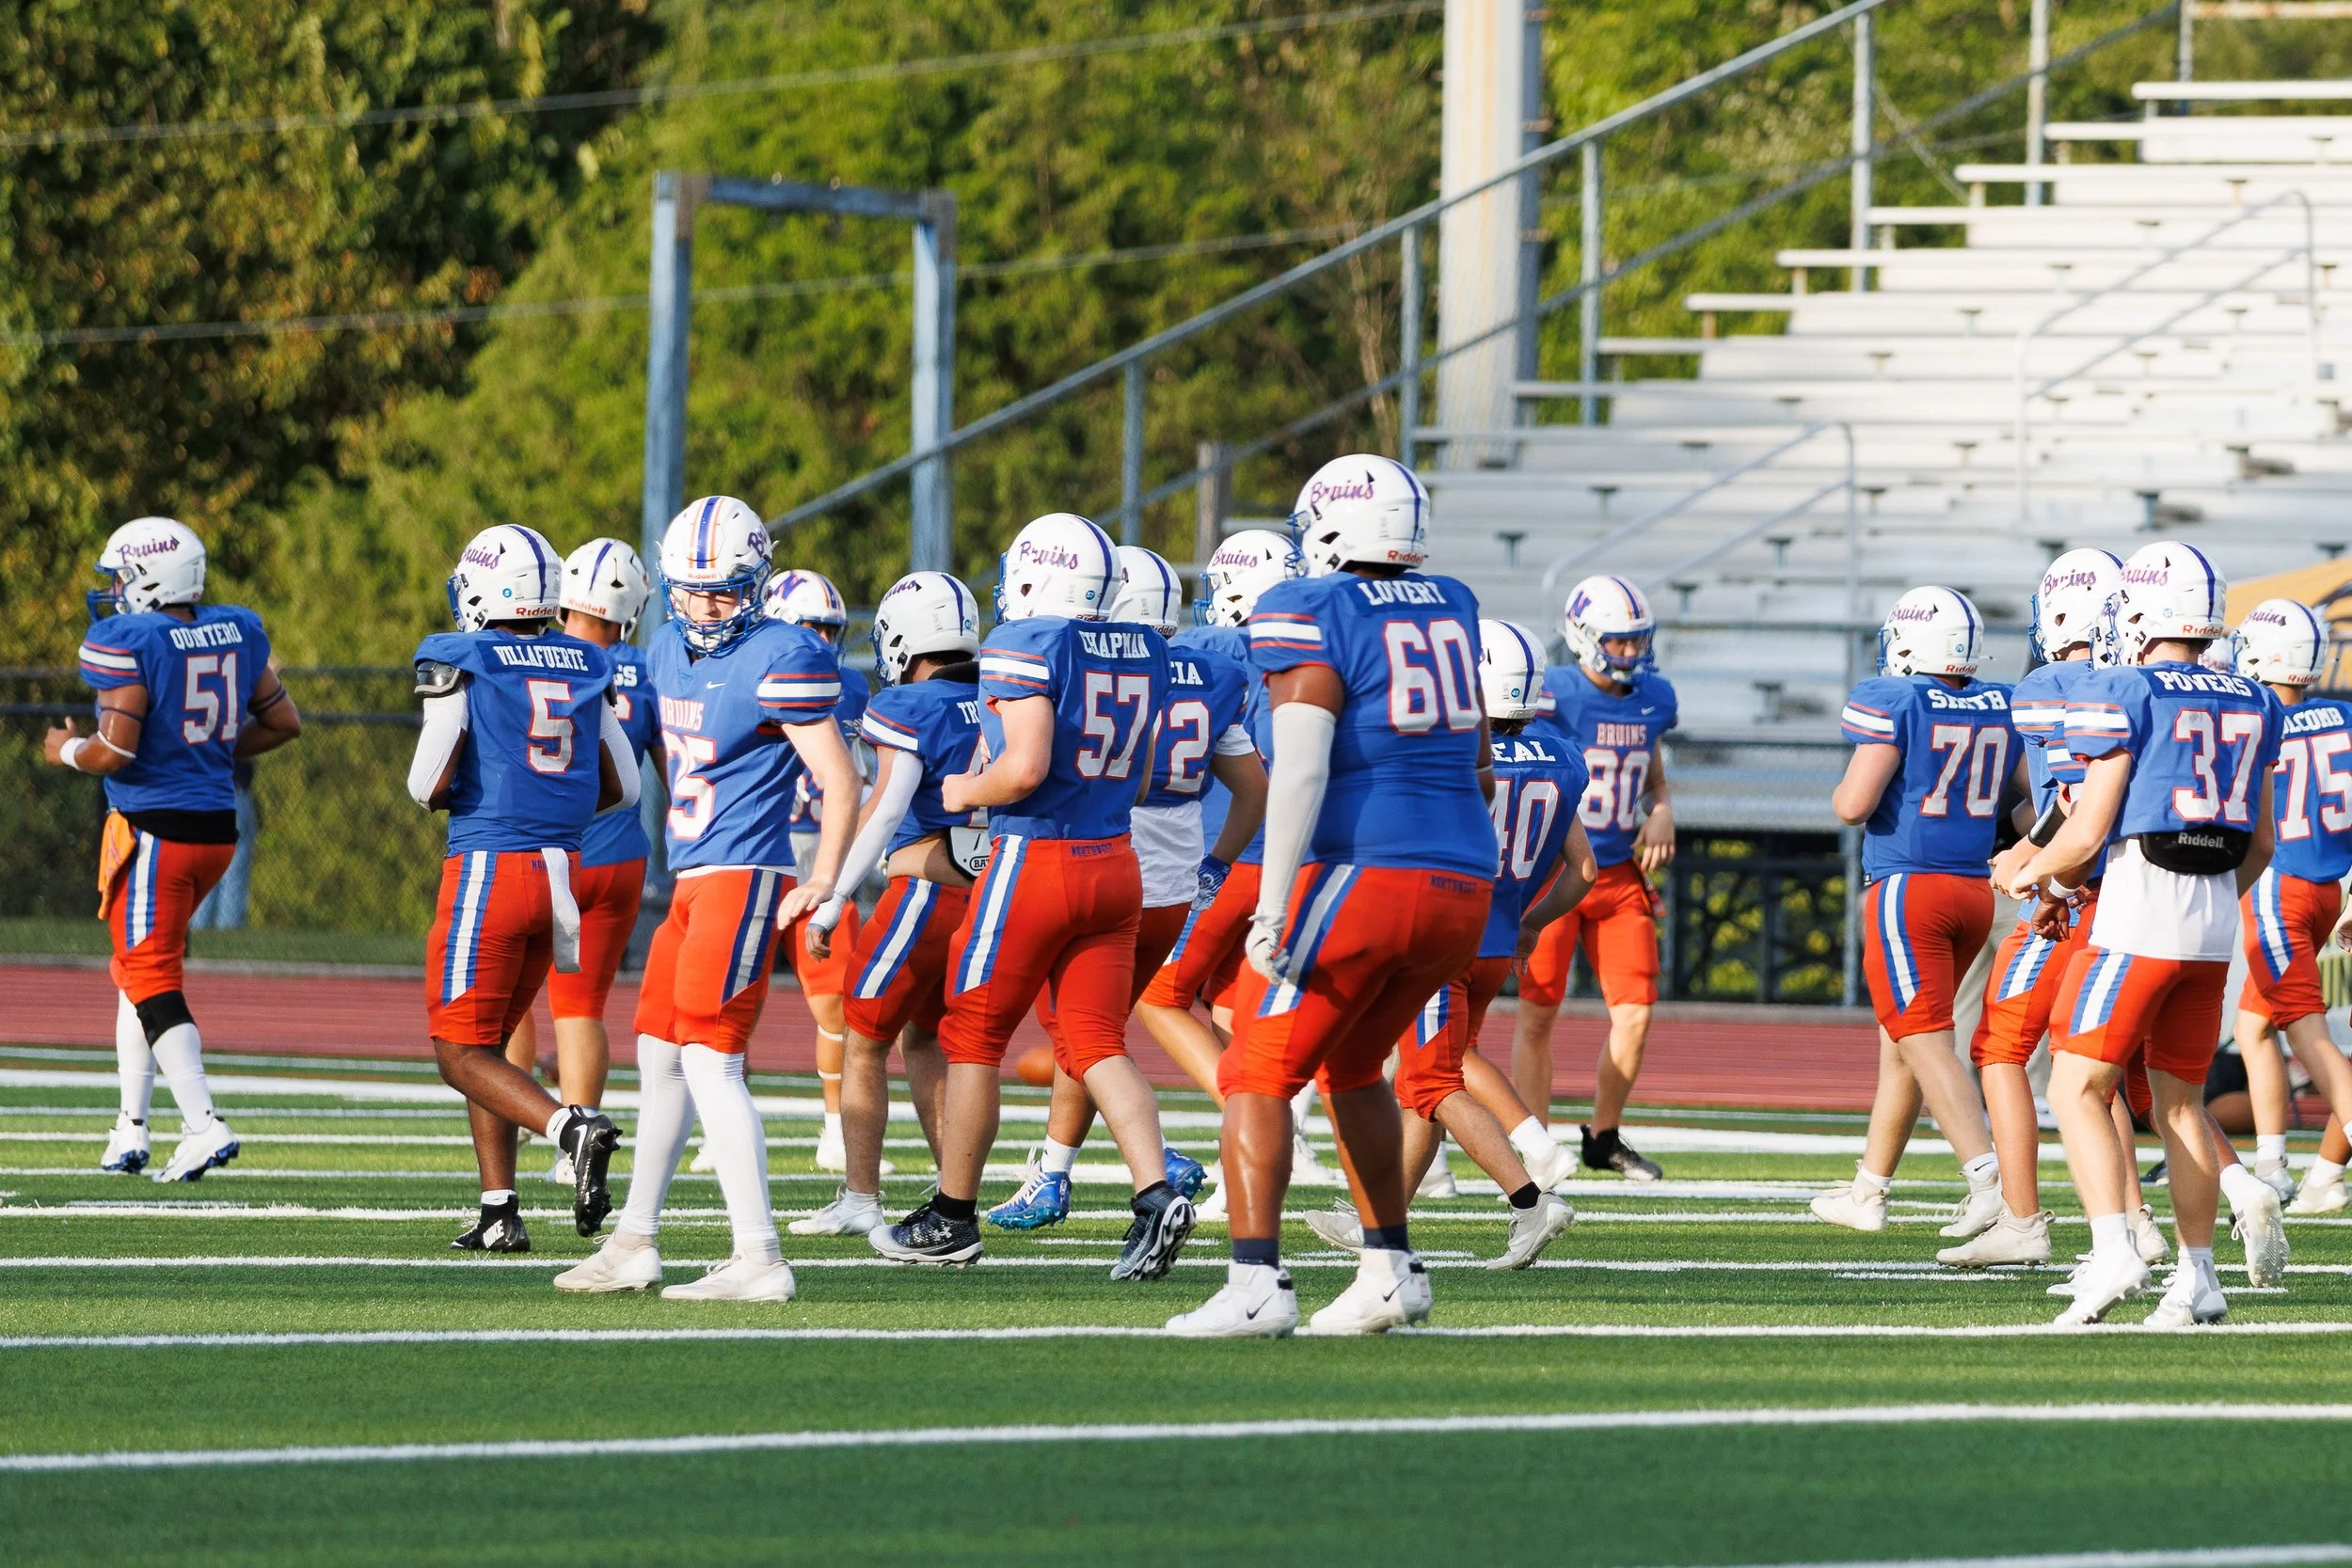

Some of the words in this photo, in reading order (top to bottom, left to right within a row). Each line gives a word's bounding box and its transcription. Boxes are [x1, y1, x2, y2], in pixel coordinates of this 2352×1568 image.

[1311, 480, 1374, 504] Bruins
[117, 535, 179, 563] Bruins
[1020, 540, 1078, 570] Bruins
[1213, 548, 1258, 568] Bruins
[1357, 579, 1447, 606] LOVERY
[2043, 568, 2097, 598] Bruins
[169, 621, 244, 651] QUINTERO
[1078, 630, 1151, 658] CHAPMAN
[492, 644, 589, 672] VILLAFUERTE
[1384, 617, 1484, 735] 60
[2153, 671, 2253, 697] POWERS
[182, 650, 240, 745] 51
[1927, 689, 2009, 711] SMITH
[526, 677, 575, 775] 5
[1075, 669, 1151, 781] 57
[1596, 721, 1647, 748] BRUINS
[1490, 740, 1557, 764] EAL
[2171, 707, 2264, 824] 37
[1919, 722, 2010, 818] 70
[1577, 747, 1651, 831] 80
[2273, 730, 2352, 843] 75
[1489, 778, 1562, 881] 40
[2178, 832, 2224, 848] Riddell
[483, 1219, 505, 1249] NIKE
